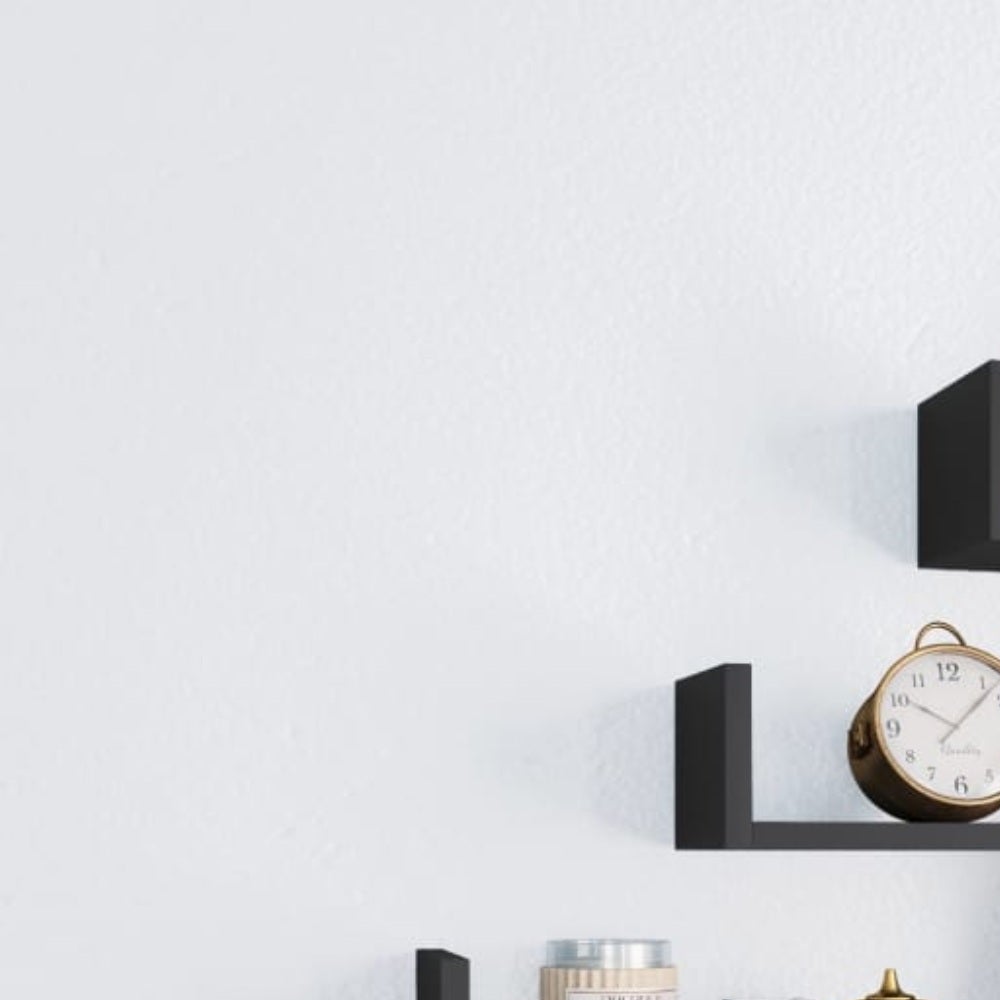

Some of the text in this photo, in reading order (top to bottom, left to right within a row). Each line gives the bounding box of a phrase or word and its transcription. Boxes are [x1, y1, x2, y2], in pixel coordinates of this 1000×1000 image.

[936, 661, 961, 682] 12
[912, 673, 925, 688] 11
[979, 676, 987, 690] 1
[890, 692, 910, 708] 10
[886, 718, 901, 739] 9
[904, 749, 916, 763] 8
[927, 766, 937, 781] 7
[984, 769, 995, 784] 5
[953, 775, 969, 795] 6
